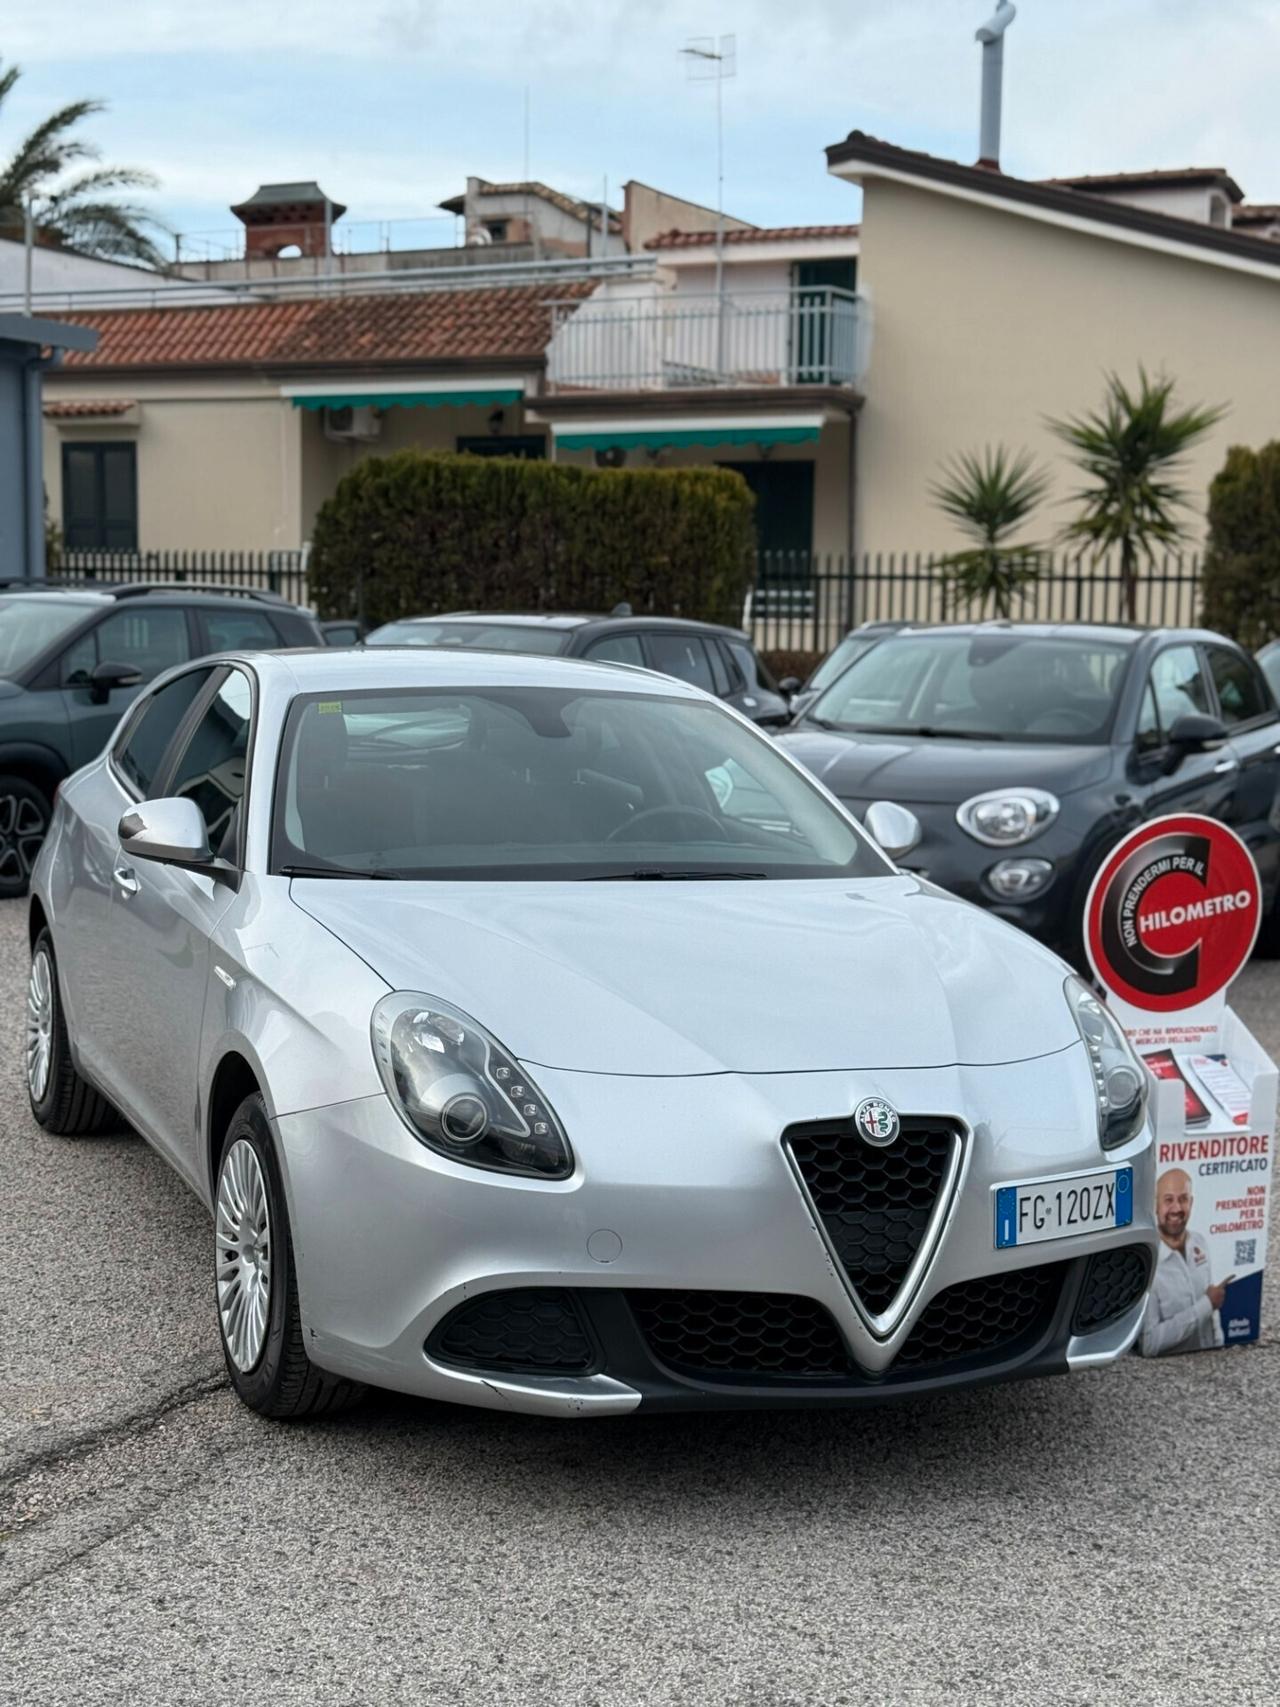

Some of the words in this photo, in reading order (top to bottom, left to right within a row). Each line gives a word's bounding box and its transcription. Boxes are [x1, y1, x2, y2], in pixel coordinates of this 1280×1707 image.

[1172, 856, 1194, 871] PER
[1194, 862, 1204, 876] IL
[1124, 859, 1171, 916] PRENDERMI
[1123, 920, 1137, 947] NON
[1160, 1135, 1269, 1162] RIVENDITORE
[1198, 1158, 1268, 1176] CERTIFICATO
[1247, 1186, 1266, 1195] NON
[1215, 1197, 1265, 1210] PRENDERMI
[1240, 1210, 1255, 1219] PER
[1257, 1208, 1265, 1218] IL
[1209, 1220, 1264, 1234] CHILOMETRO
